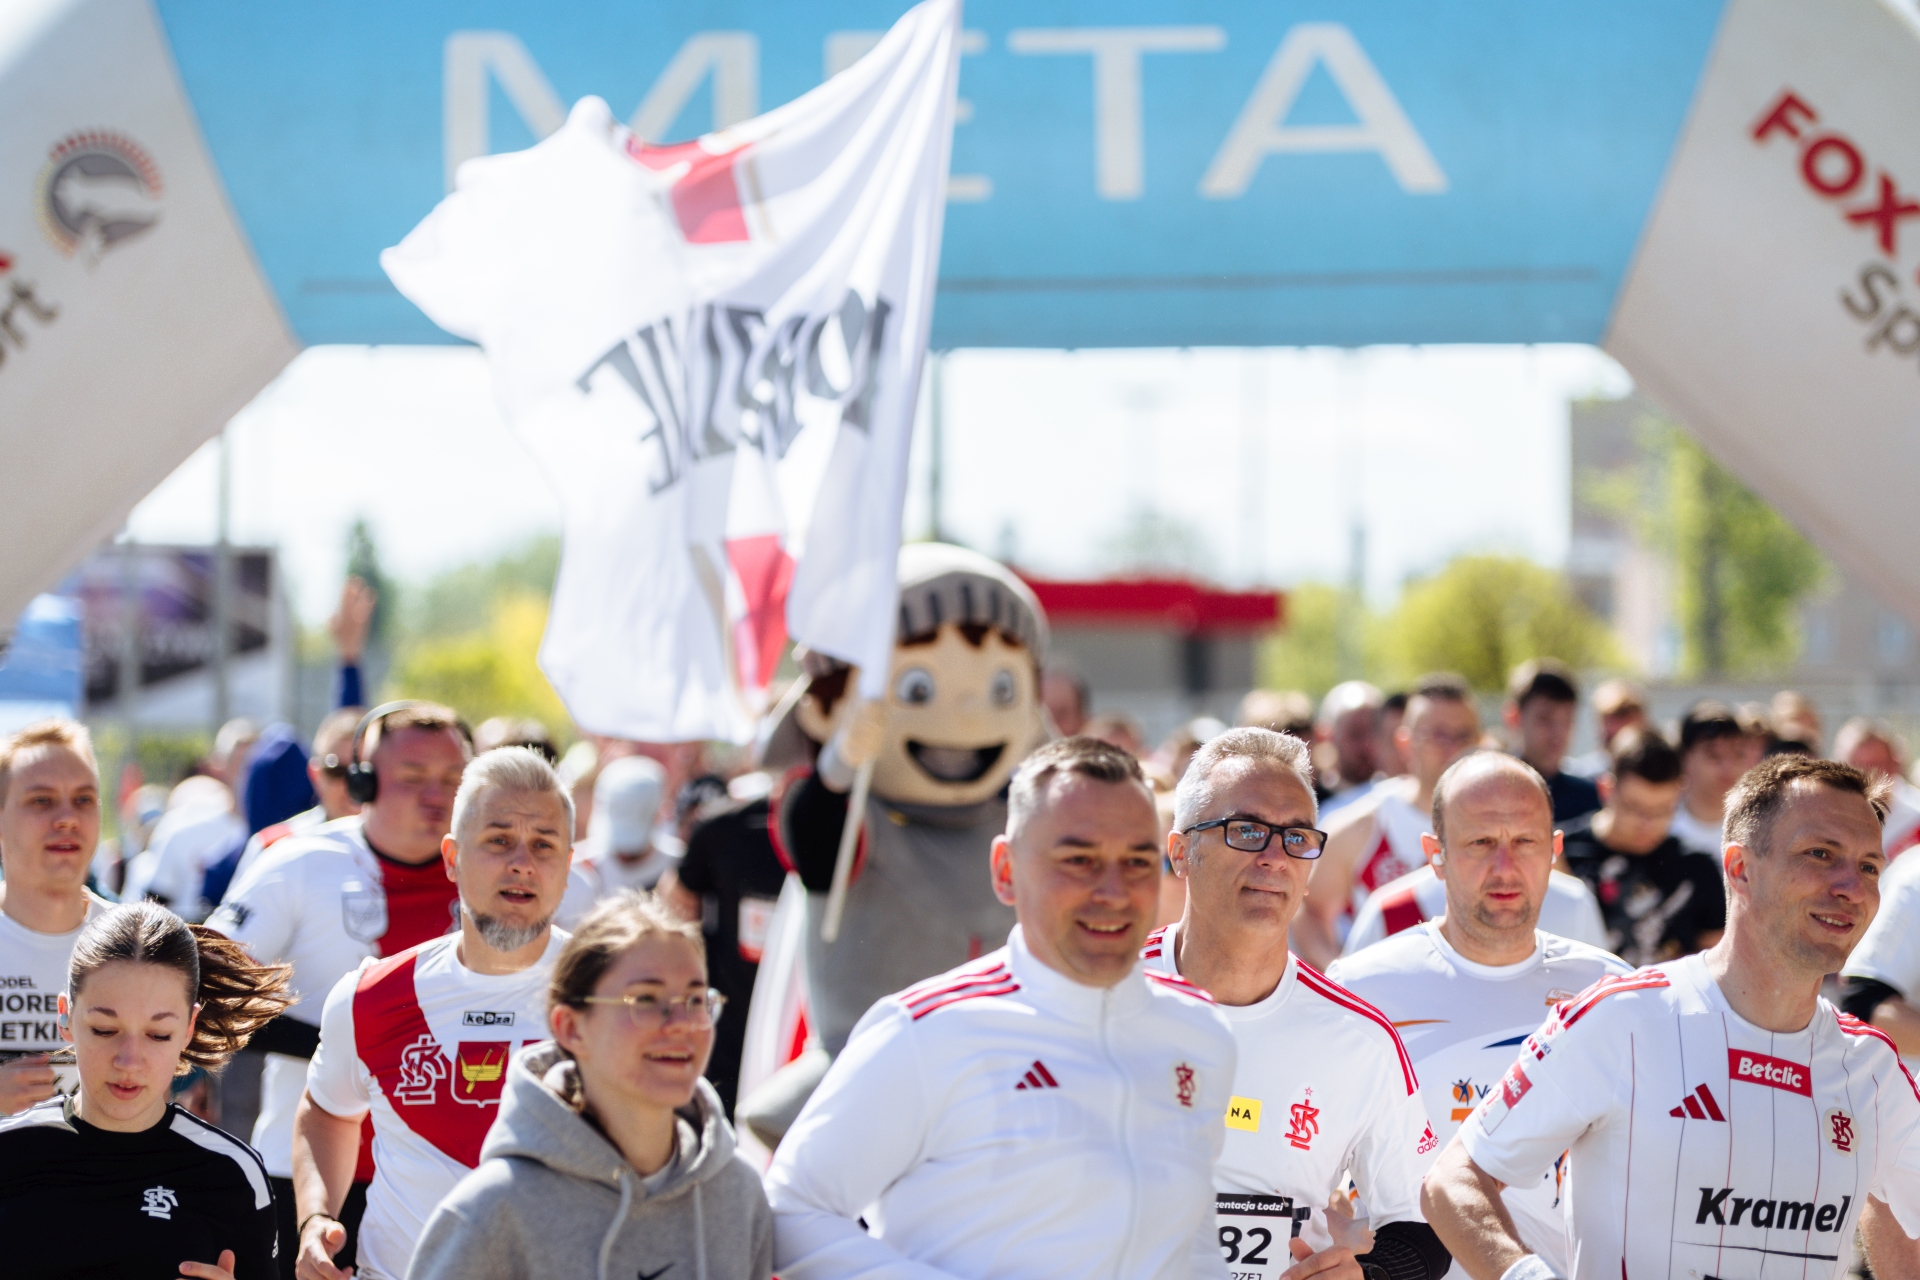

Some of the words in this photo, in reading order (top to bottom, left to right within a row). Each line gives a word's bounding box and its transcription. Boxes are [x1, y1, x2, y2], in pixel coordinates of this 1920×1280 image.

[1751, 88, 1920, 260] FOX
[1, 1021, 64, 1041] ETKI
[1738, 1056, 1803, 1089] Betclic
[1257, 1202, 1284, 1211] Łodzi
[1695, 1187, 1852, 1233] Kramel
[1218, 1226, 1272, 1265] 82
